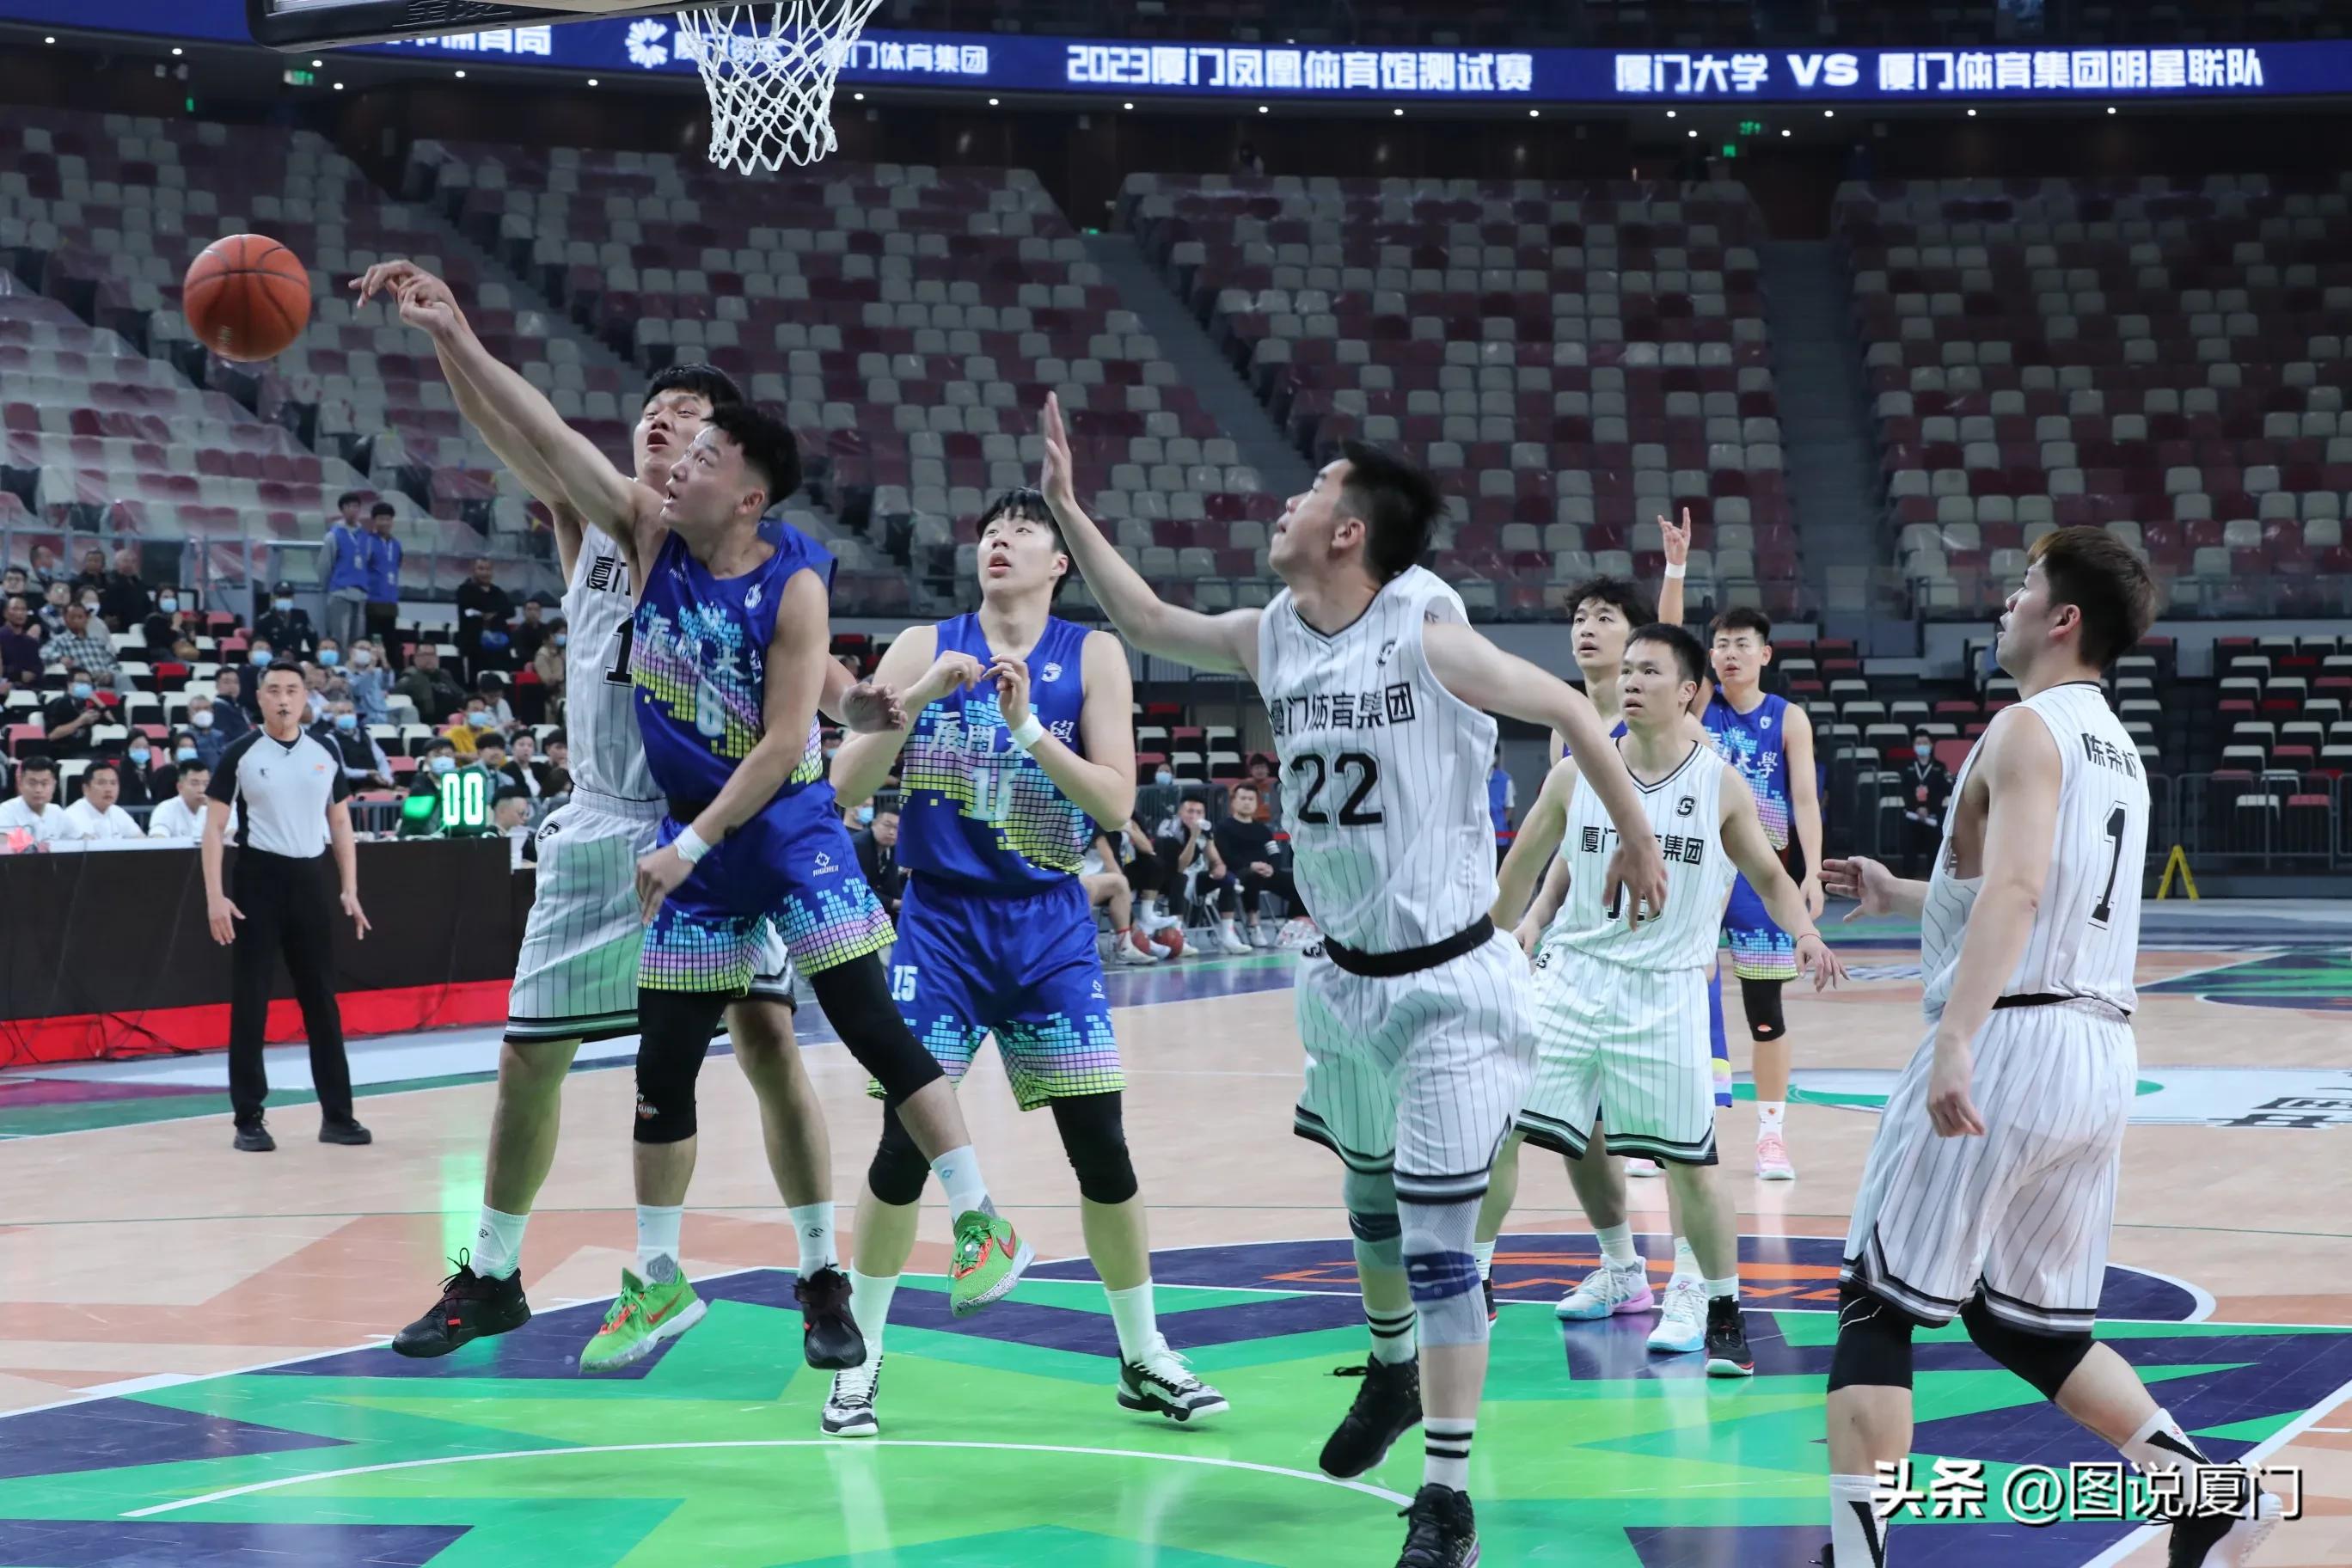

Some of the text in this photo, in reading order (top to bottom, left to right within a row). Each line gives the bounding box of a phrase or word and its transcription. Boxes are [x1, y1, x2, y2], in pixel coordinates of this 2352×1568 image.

[1066, 46, 1534, 92] 2023厦门凤凰体育馆测试赛
[1615, 52, 1768, 93] 厦门大学
[1787, 53, 1859, 87] VS
[1878, 47, 2264, 91] 厦门体育集团明星联队
[1269, 682, 1416, 736] 厦门体育集团
[441, 772, 484, 826] 00
[1290, 753, 1382, 825] 22
[1581, 825, 1705, 866] 厦门集团
[2092, 807, 2126, 922] 1
[891, 965, 918, 1001] 15
